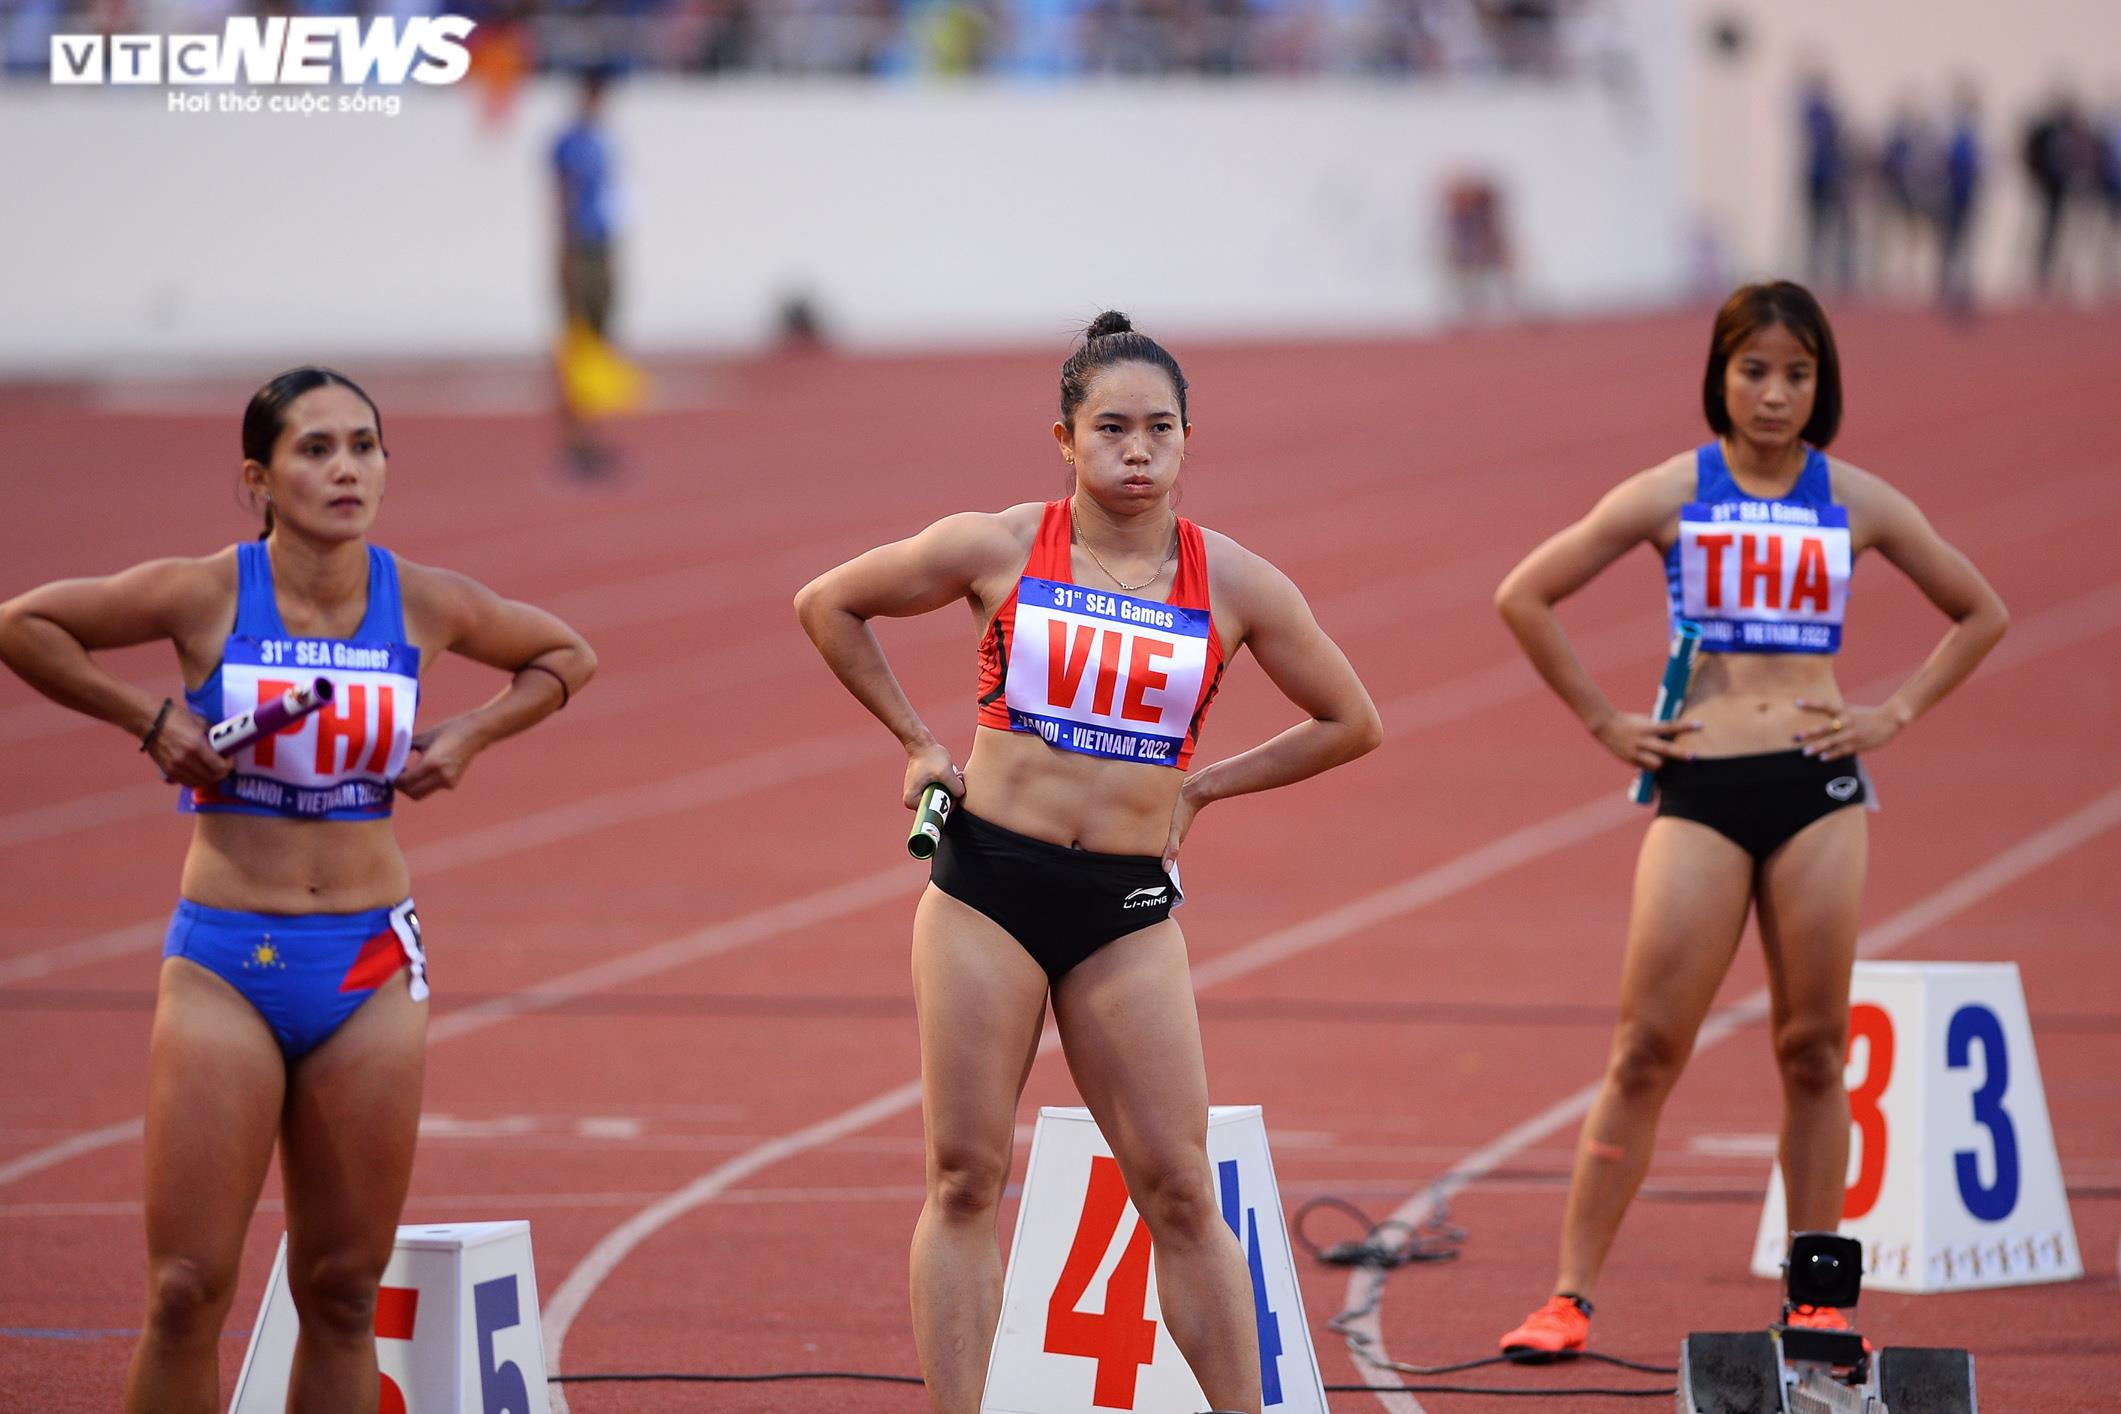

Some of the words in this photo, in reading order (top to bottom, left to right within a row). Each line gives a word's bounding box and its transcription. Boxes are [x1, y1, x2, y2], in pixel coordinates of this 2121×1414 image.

[1085, 593, 1116, 617] SEA
[1120, 600, 1174, 629] Games
[1696, 533, 1829, 612] THA
[295, 640, 331, 666] SEA
[333, 642, 389, 670] Games
[1048, 618, 1174, 724] VIE
[254, 678, 394, 776] PHI
[1073, 727, 1137, 757] VIETNAM
[1138, 738, 1170, 760] 2022
[1123, 896, 1168, 909] LI-NING
[1947, 1003, 2020, 1223] 3
[1043, 1155, 1157, 1410] 4
